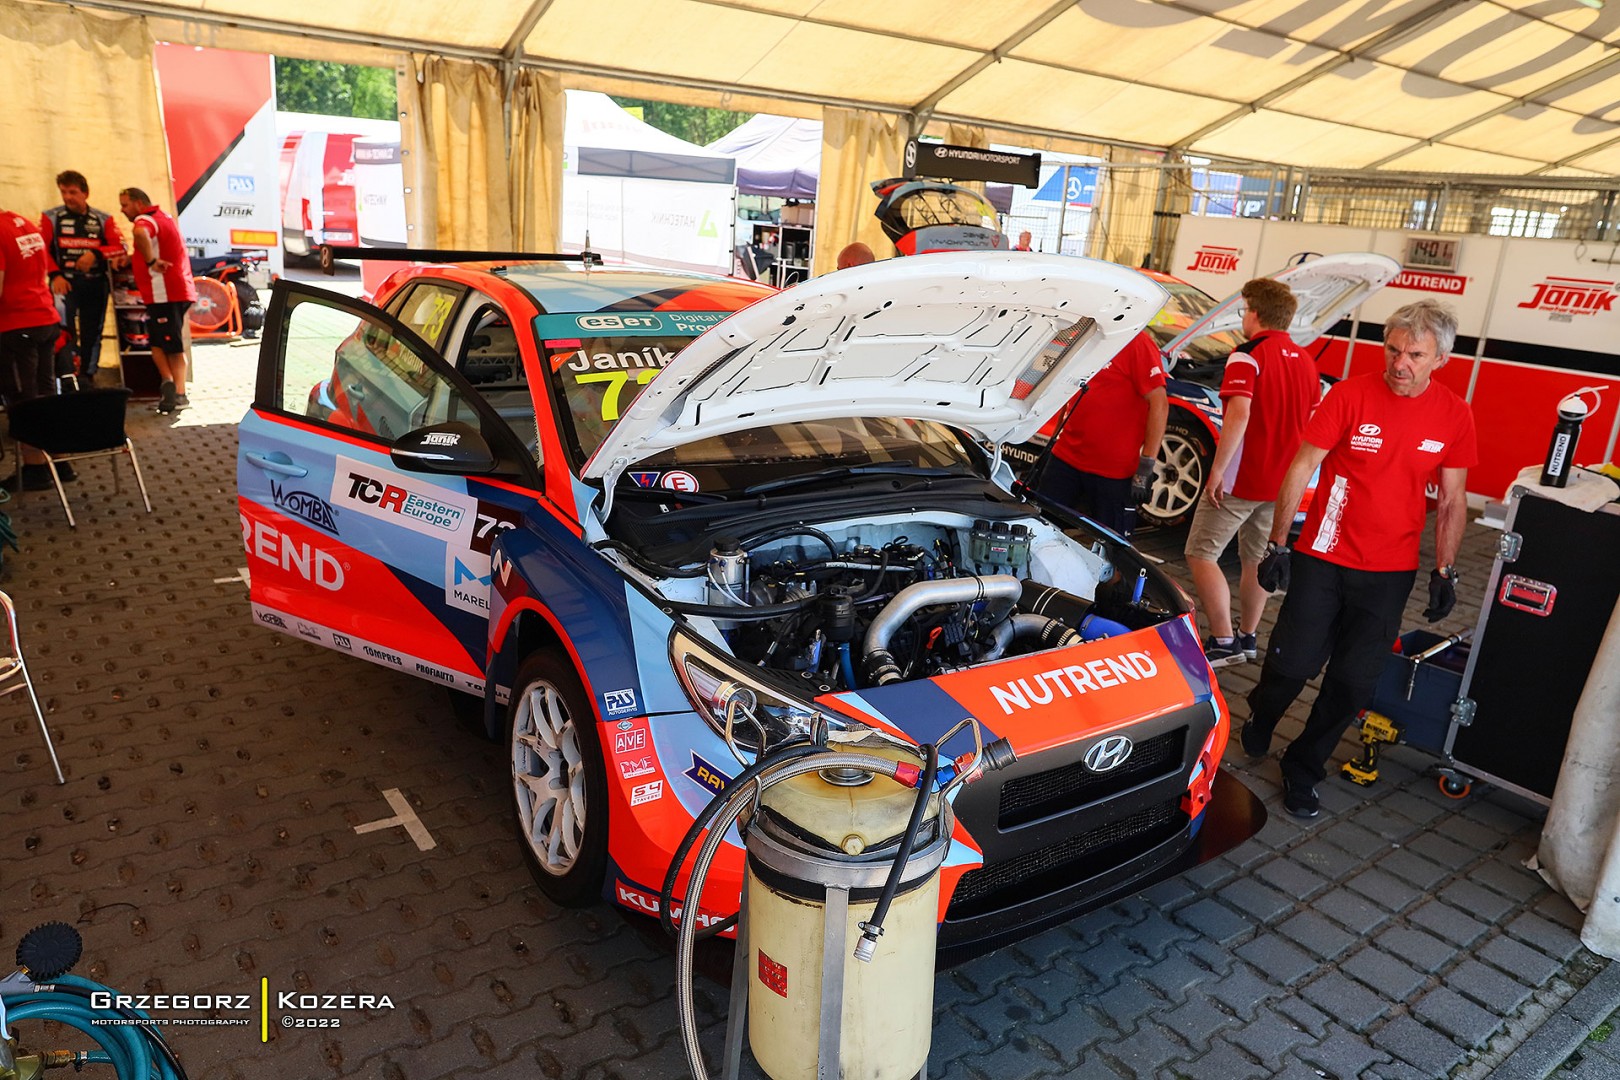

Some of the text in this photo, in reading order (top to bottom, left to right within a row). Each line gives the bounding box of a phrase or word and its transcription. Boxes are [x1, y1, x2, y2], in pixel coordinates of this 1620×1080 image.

[1390, 273, 1462, 291] NUTREND
[669, 314, 718, 322] Digital
[567, 347, 676, 372] Janík
[1550, 435, 1567, 473] NUTREND
[348, 472, 407, 514] TCR
[671, 477, 688, 490] E
[270, 480, 340, 536] WOMBAT
[403, 504, 452, 528] Europe
[407, 494, 461, 519] Eastern
[363, 646, 402, 666] TOMPRES
[416, 663, 455, 684] PROFIAUTO
[989, 653, 1158, 716] NUTREND
[617, 732, 644, 749] AVE
